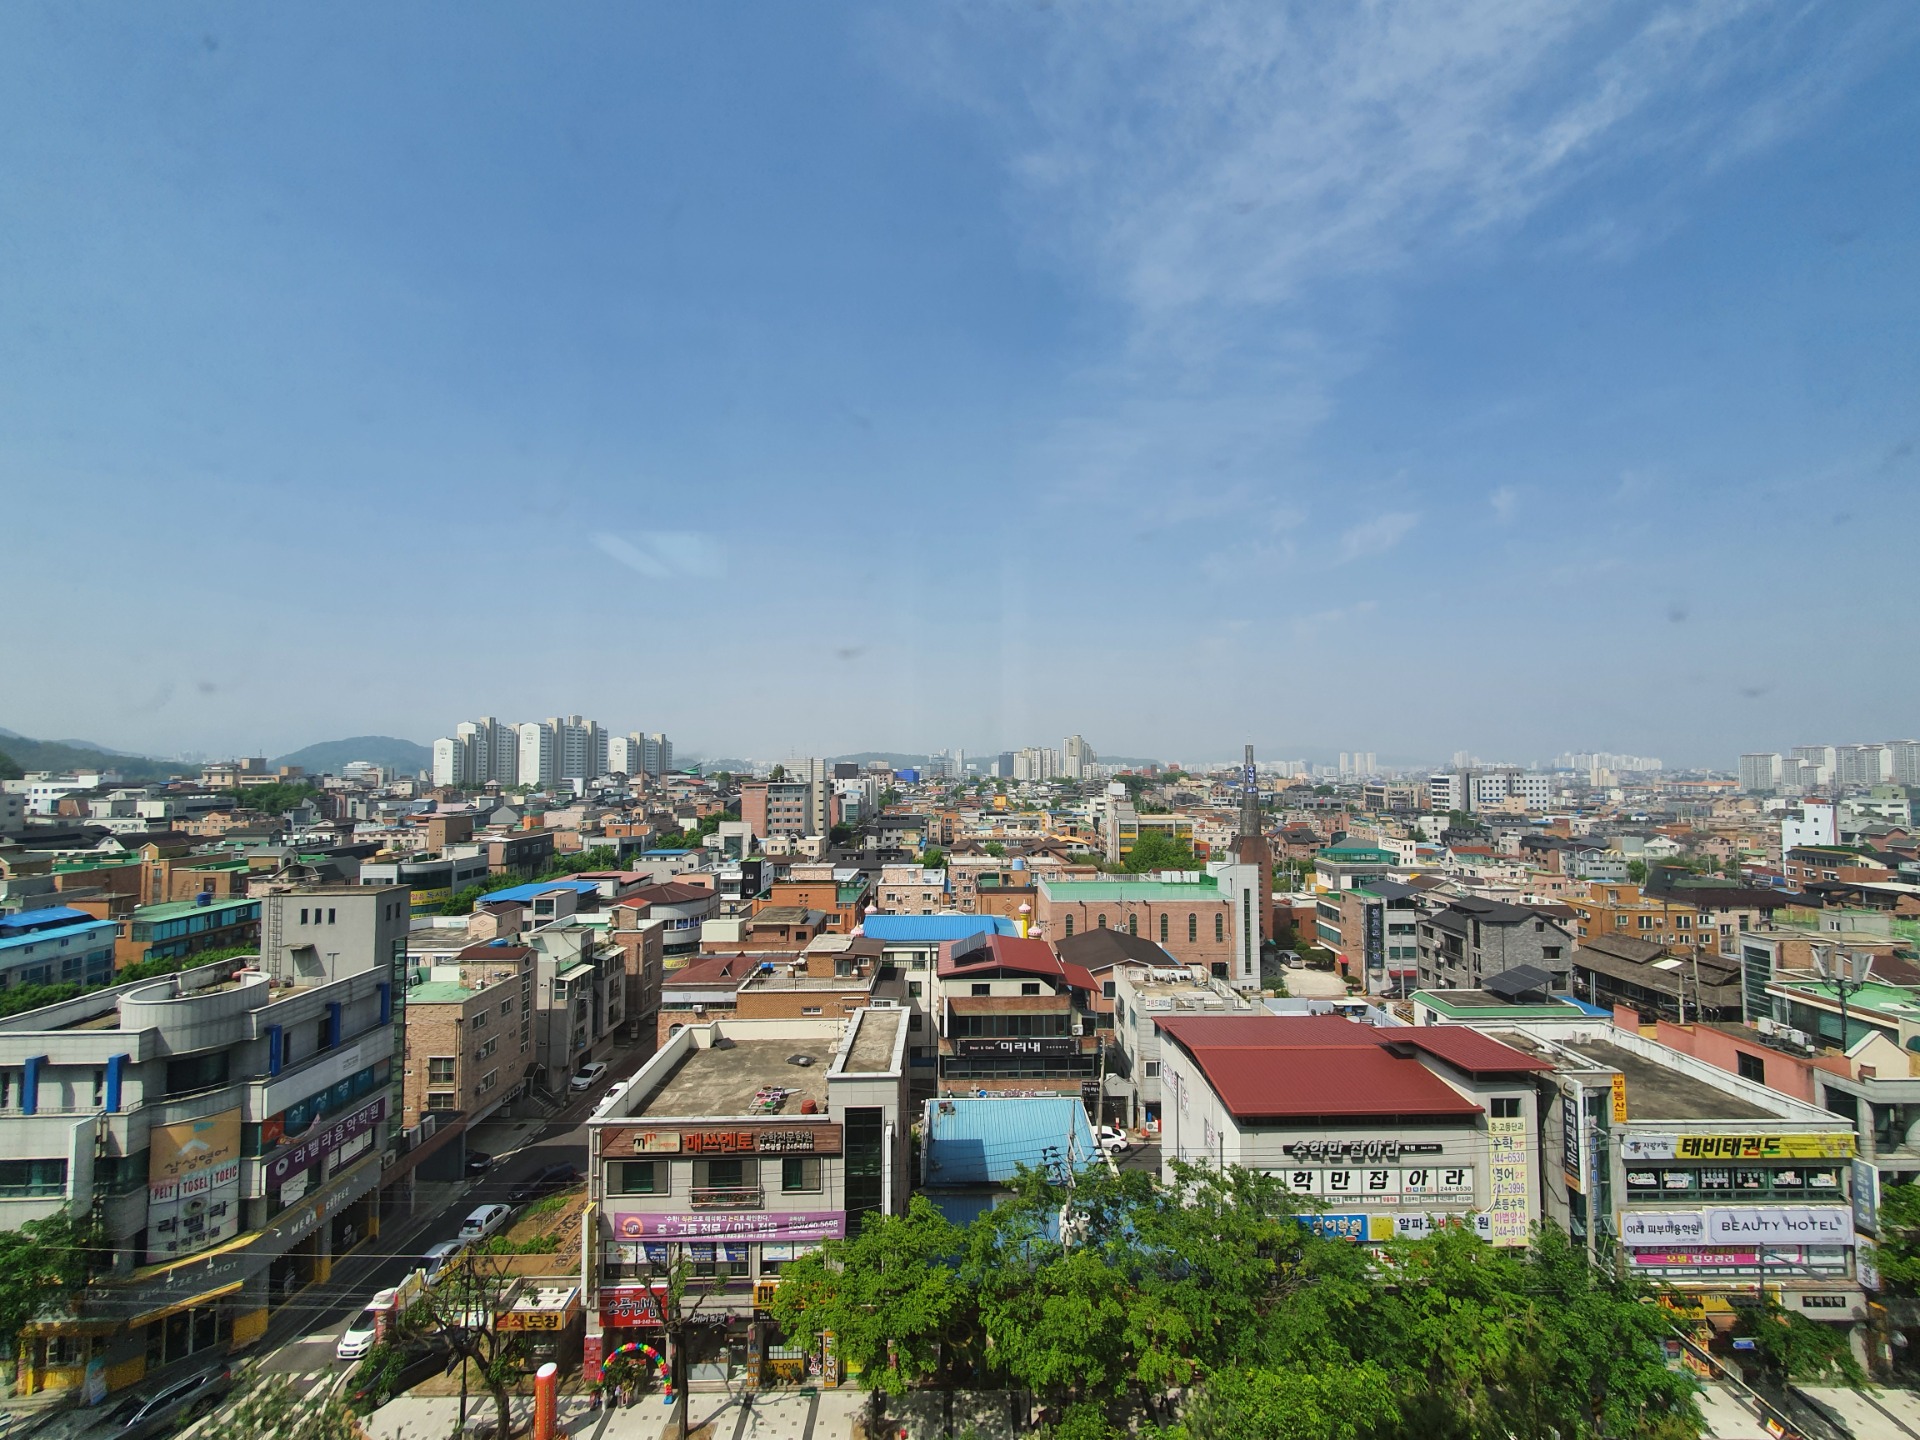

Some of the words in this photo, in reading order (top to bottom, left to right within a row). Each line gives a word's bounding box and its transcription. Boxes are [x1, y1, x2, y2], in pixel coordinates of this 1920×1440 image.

[1000, 1041, 1041, 1053] 미리내
[1613, 1080, 1625, 1112] 부동산
[294, 1104, 380, 1163] 라벨라음악학원
[686, 1132, 754, 1152] 매쓰멘토
[760, 1131, 814, 1143] 수학전문학원
[1564, 1098, 1578, 1167] 태비태권도
[1292, 1140, 1343, 1159] 수학만
[1350, 1140, 1402, 1158] 잡아라
[1493, 1136, 1513, 1150] 수학
[1514, 1141, 1525, 1149] 3F
[1682, 1137, 1781, 1156] 태비태권도
[165, 1146, 229, 1175] 삼성영어
[154, 1185, 173, 1200] PELT
[183, 1175, 209, 1194] TOSEL
[215, 1165, 238, 1183] TOEIC
[1493, 1168, 1514, 1181] 영어
[1493, 1183, 1525, 1194] 241-3996
[1494, 1198, 1525, 1210] 초등수학
[290, 1210, 317, 1236] MEGA
[1312, 1216, 1362, 1236] 영어학원
[1494, 1211, 1526, 1224] 마법암산
[1721, 1221, 1780, 1232] BEAUTY
[1787, 1221, 1839, 1231] HOTEL
[677, 1224, 698, 1235] 고등
[701, 1223, 721, 1233] 전문
[1494, 1226, 1526, 1236] 244-9113
[1626, 1224, 1645, 1234] 이레
[1648, 1223, 1700, 1236] 피부미용학원
[165, 1275, 193, 1292] SIZE
[206, 1260, 239, 1277] SHOT
